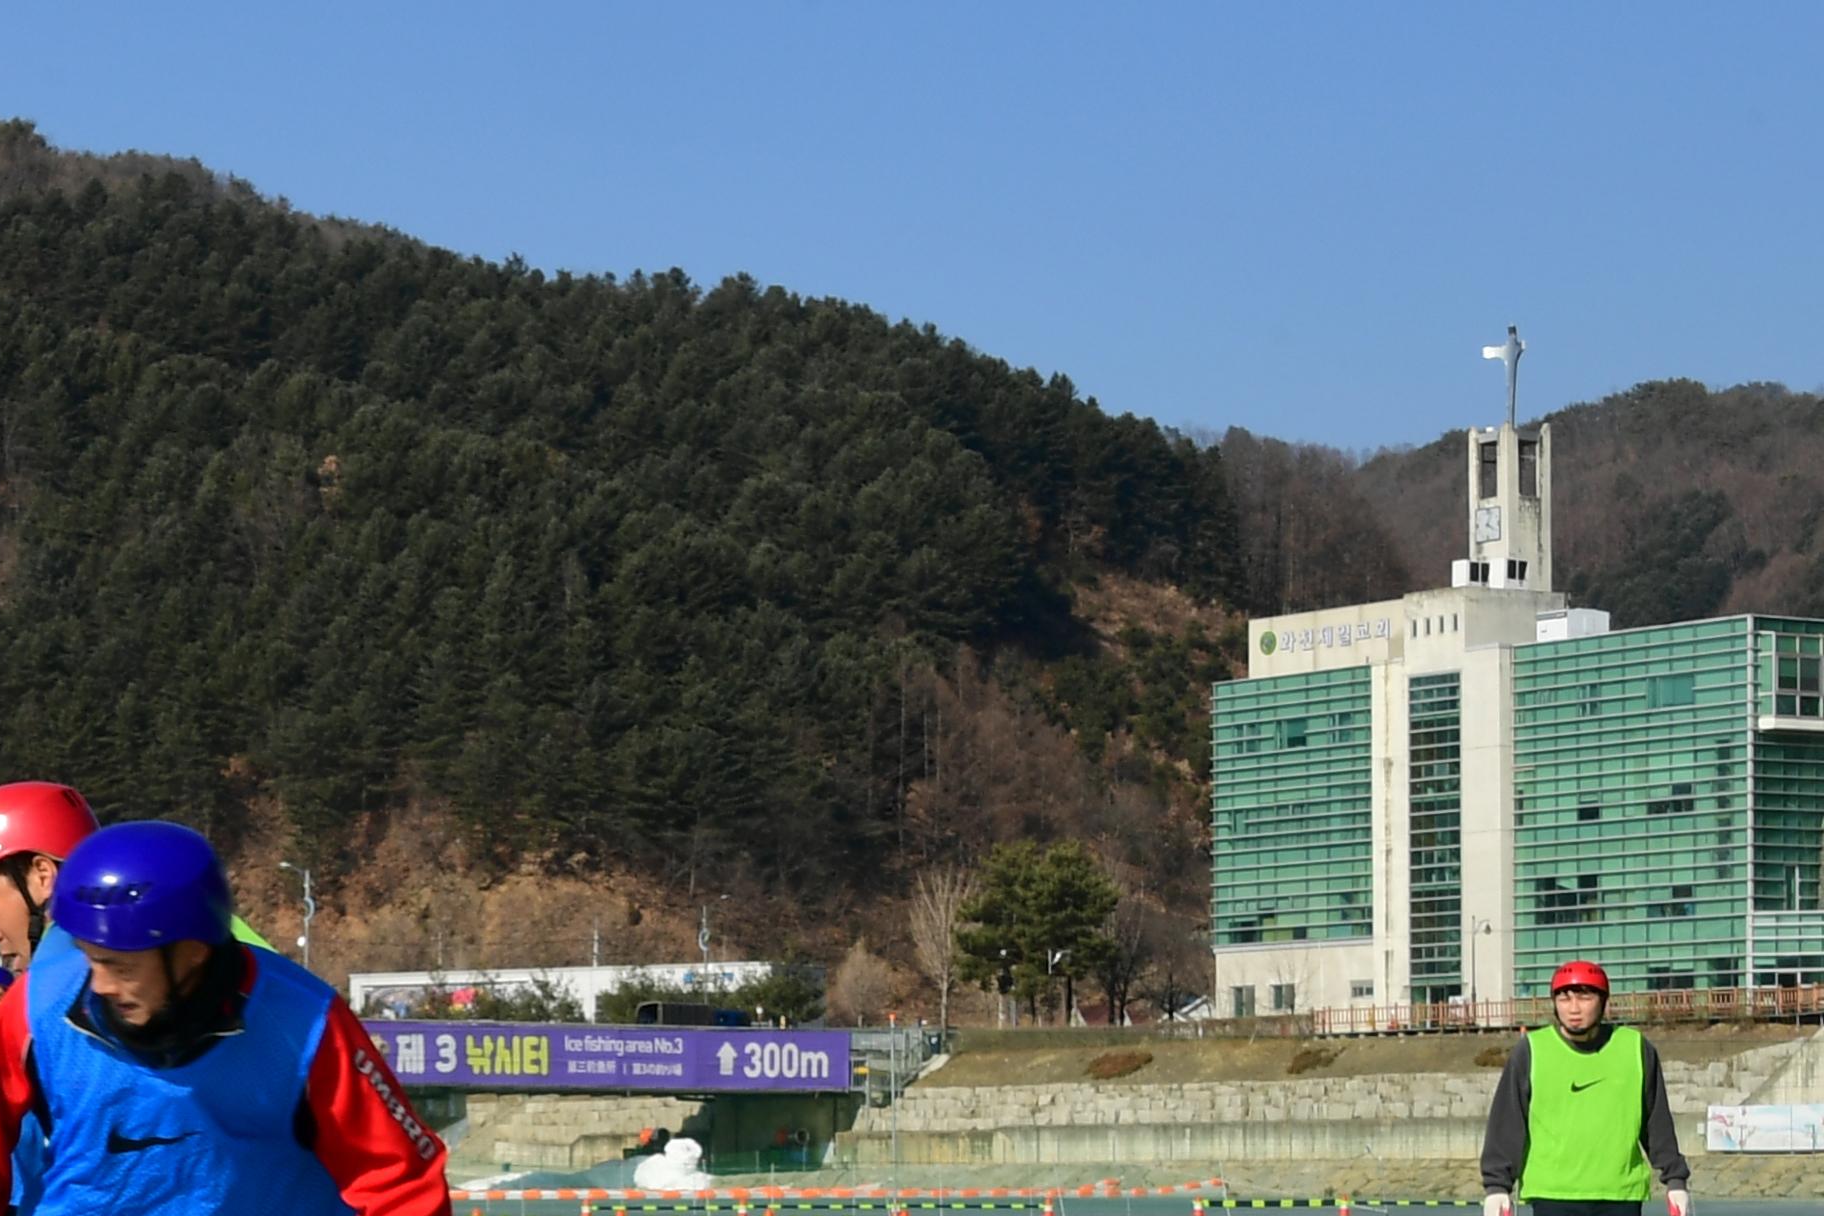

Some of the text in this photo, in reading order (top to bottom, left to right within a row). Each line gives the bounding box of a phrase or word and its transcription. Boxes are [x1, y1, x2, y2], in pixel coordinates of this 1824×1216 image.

[396, 1034, 549, 1075] 제 3 낚시터
[743, 1042, 829, 1078] 300m
